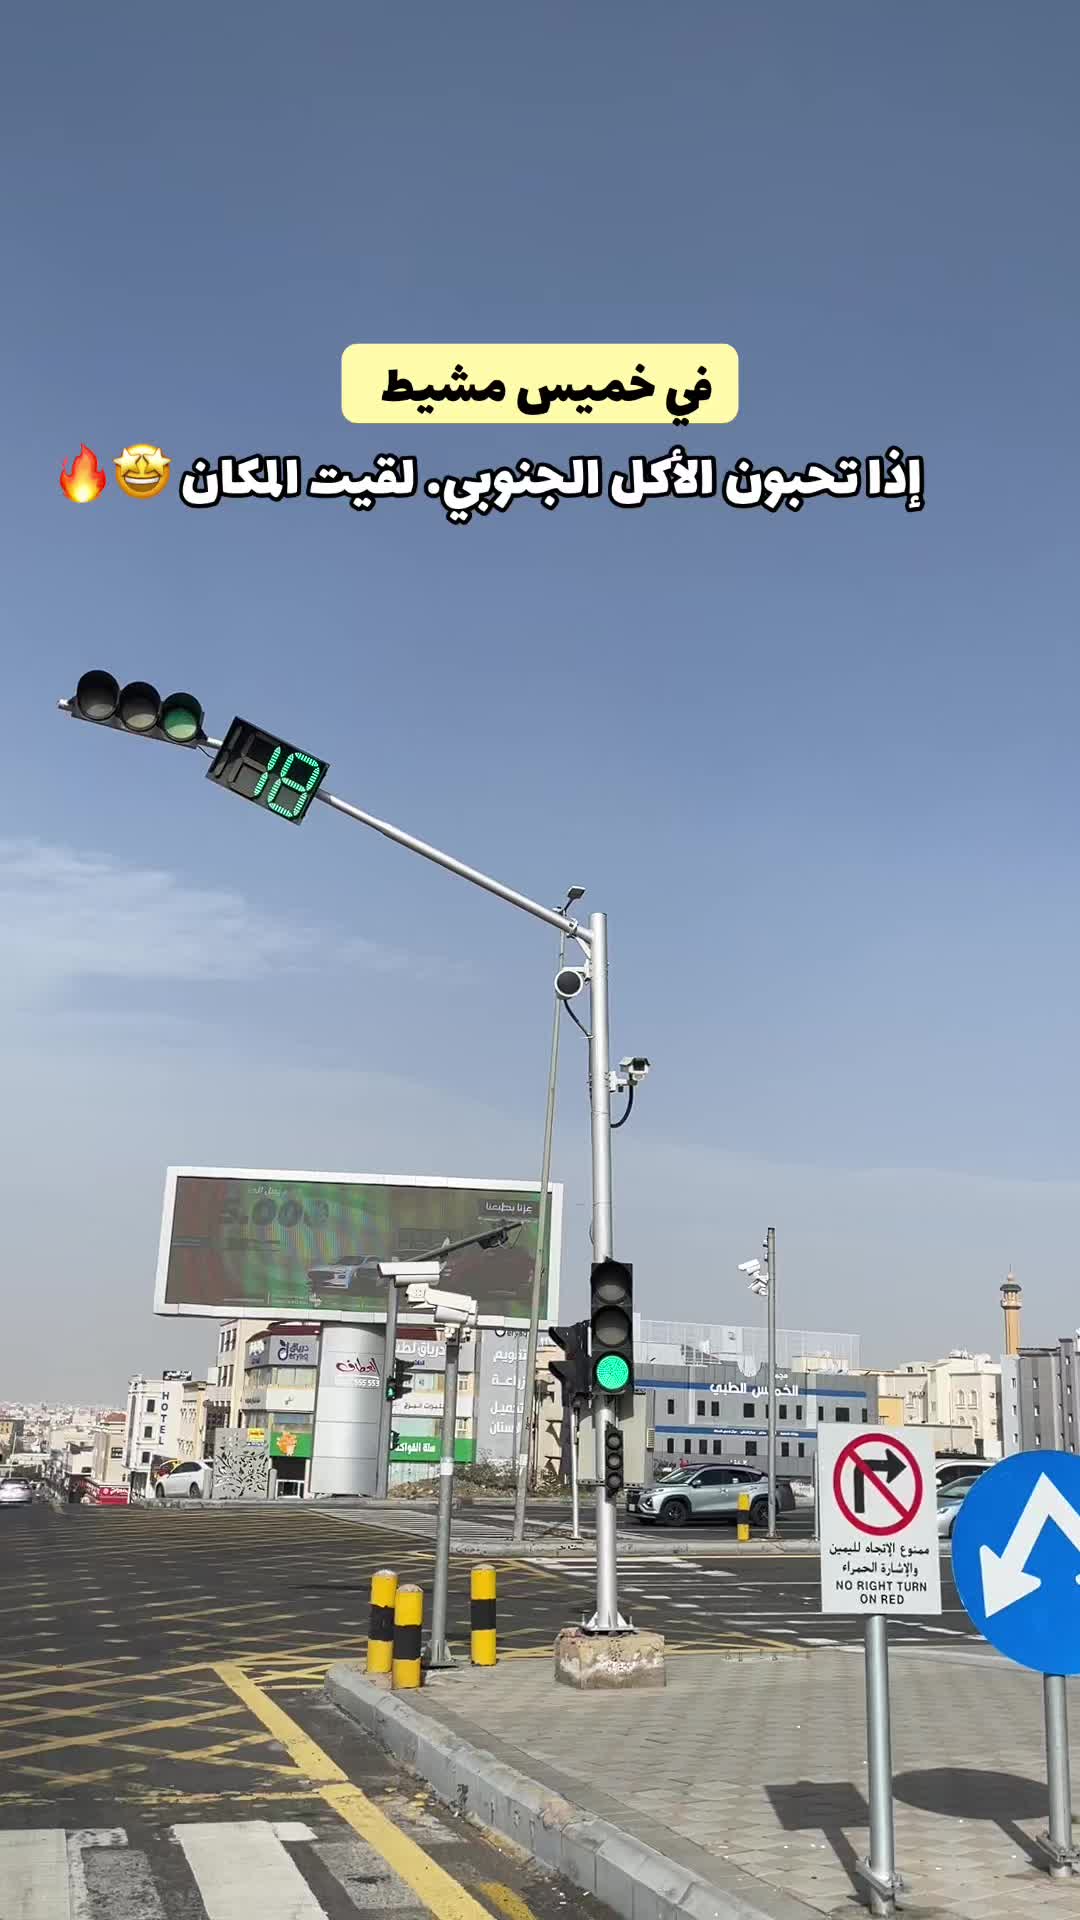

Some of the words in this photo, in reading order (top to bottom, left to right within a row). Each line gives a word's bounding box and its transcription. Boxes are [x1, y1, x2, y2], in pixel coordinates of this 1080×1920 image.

[254, 746, 320, 818] 18
[418, 1343, 446, 1358] درياق
[336, 1357, 380, 1376] العطاف
[710, 1381, 748, 1395] الطبي
[752, 1384, 799, 1398] الخمس
[159, 1392, 169, 1445] HOTEL
[829, 1541, 861, 1555] لليمين
[865, 1541, 896, 1557] الإتجاه
[900, 1545, 930, 1558] ممنوع
[842, 1561, 877, 1575] الحمراء
[880, 1562, 918, 1577] والإشارة
[836, 1580, 853, 1591] NO
[857, 1580, 893, 1591] RIGHT
[897, 1581, 927, 1592] TURN
[860, 1593, 877, 1605] ON
[880, 1594, 905, 1605] RED
